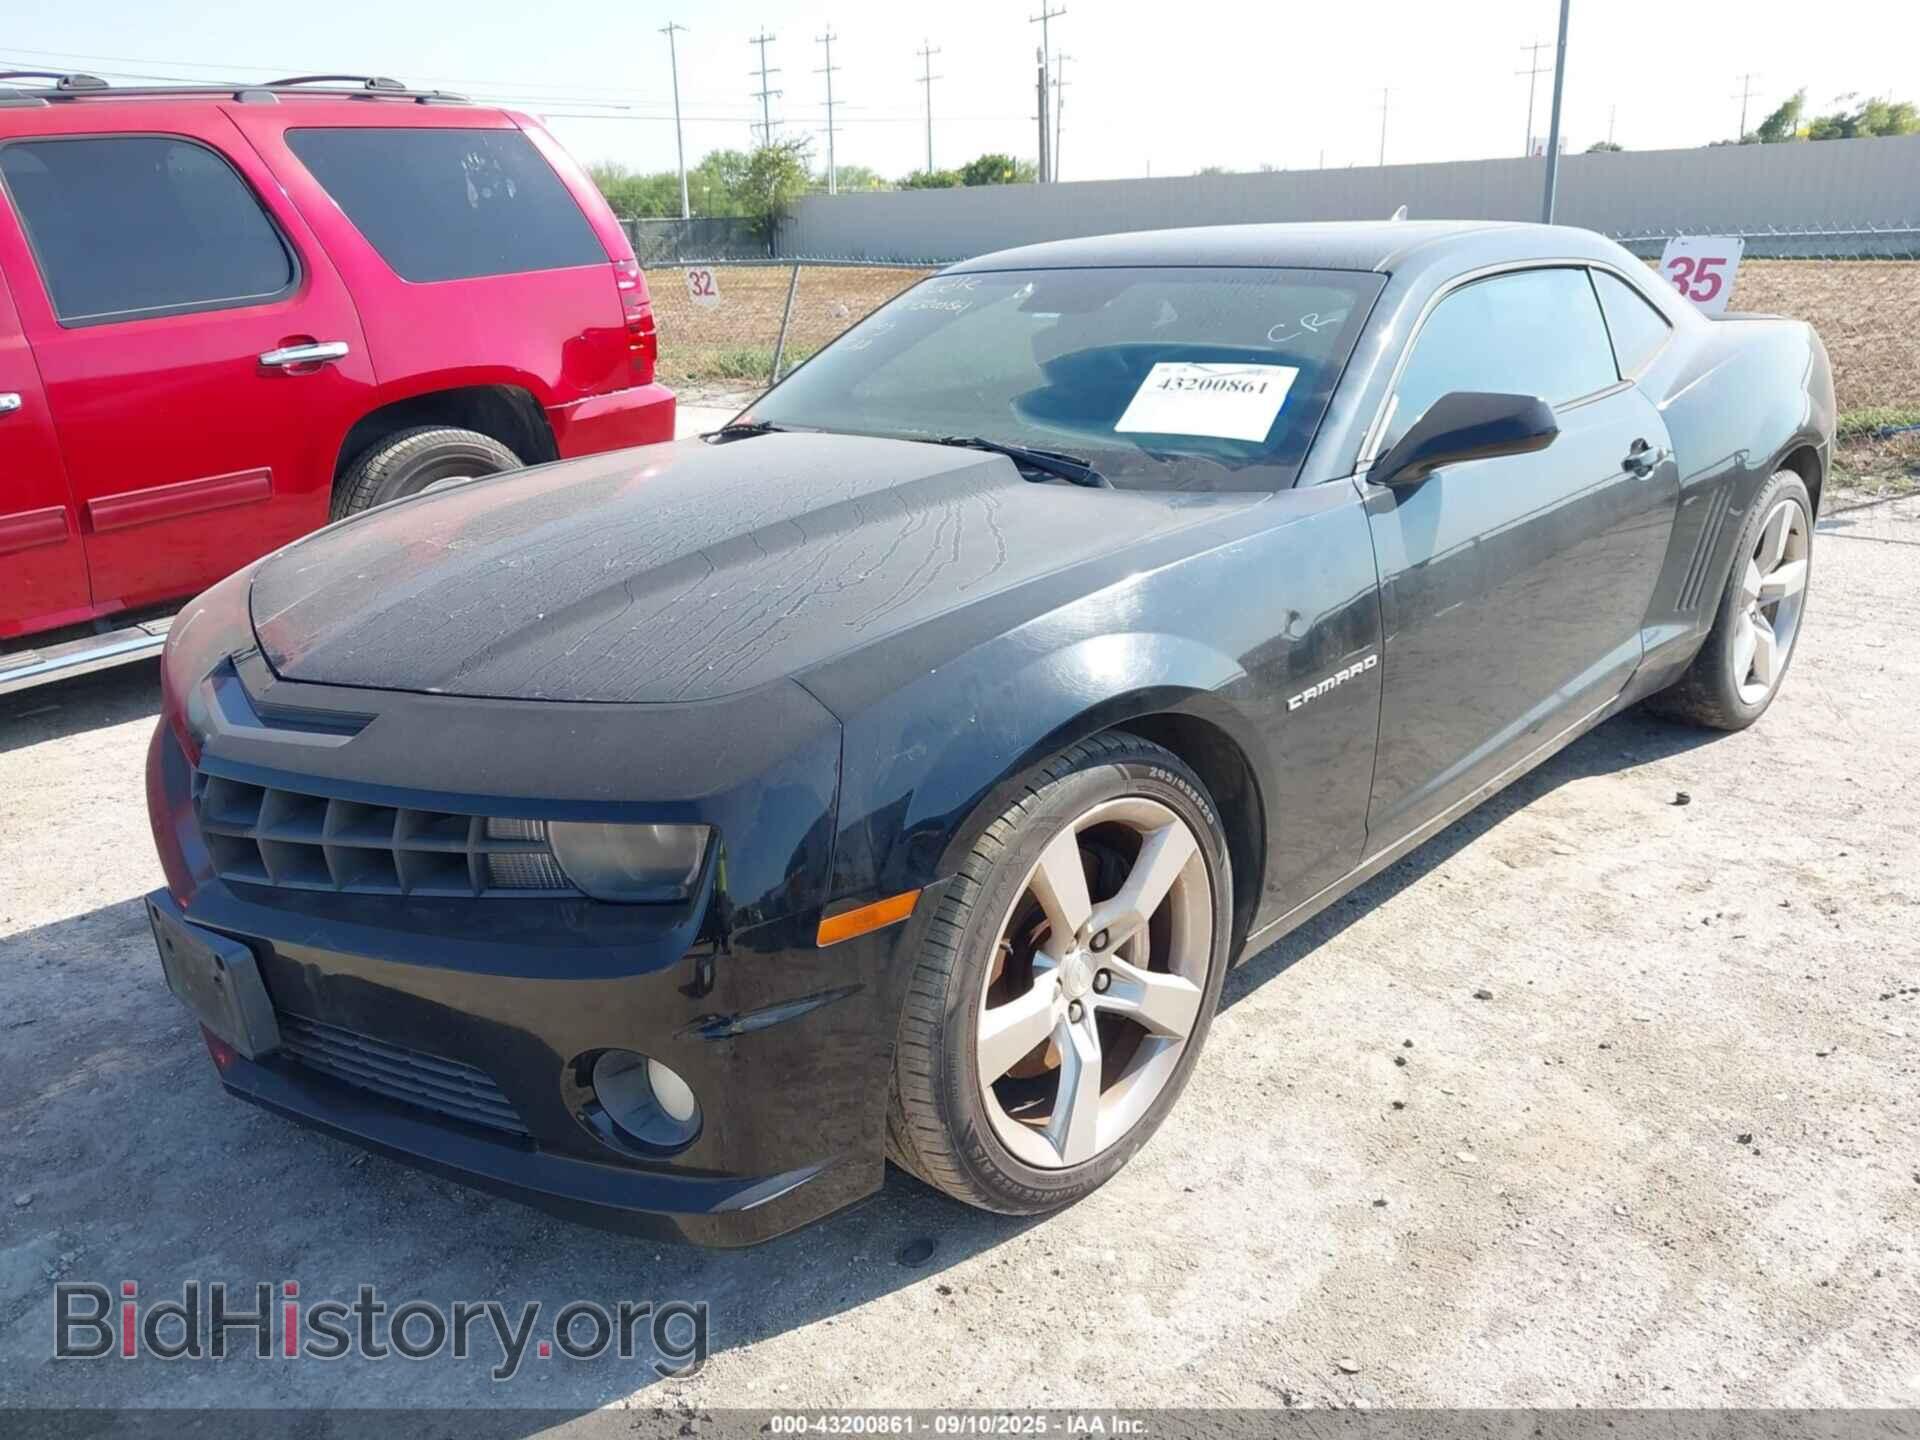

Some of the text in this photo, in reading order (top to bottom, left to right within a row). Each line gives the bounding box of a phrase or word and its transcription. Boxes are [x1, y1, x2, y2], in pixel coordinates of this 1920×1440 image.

[689, 271, 716, 296] 32
[1667, 257, 1727, 302] 35
[1157, 377, 1269, 395] 43200861
[1287, 654, 1378, 711] CAMARO
